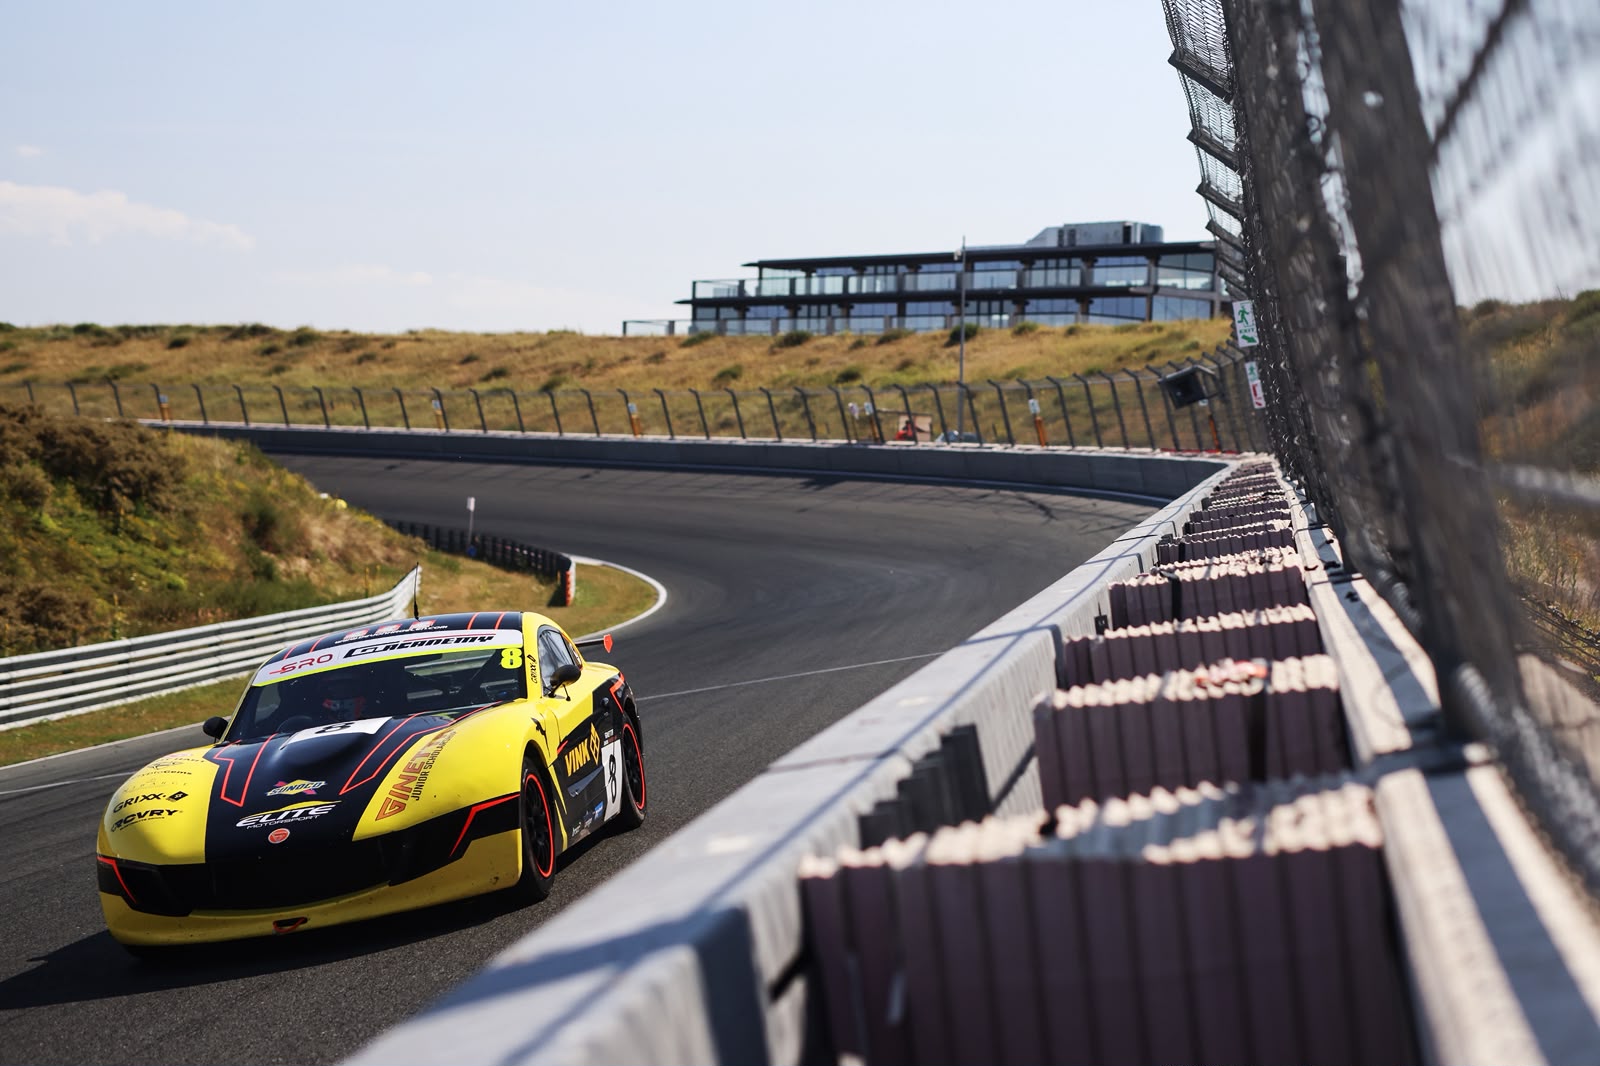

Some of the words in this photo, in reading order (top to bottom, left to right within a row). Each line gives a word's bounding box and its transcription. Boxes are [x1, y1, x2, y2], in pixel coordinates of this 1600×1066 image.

[269, 653, 334, 675] SRO
[501, 648, 523, 670] 8
[314, 722, 356, 734] 8
[564, 738, 591, 777] VINK
[267, 781, 326, 796] SUNOCO
[411, 770, 430, 801] JUNIOR
[608, 753, 617, 805] 8
[235, 804, 337, 827] ELITE
[246, 815, 321, 830] MOTORSPORT
